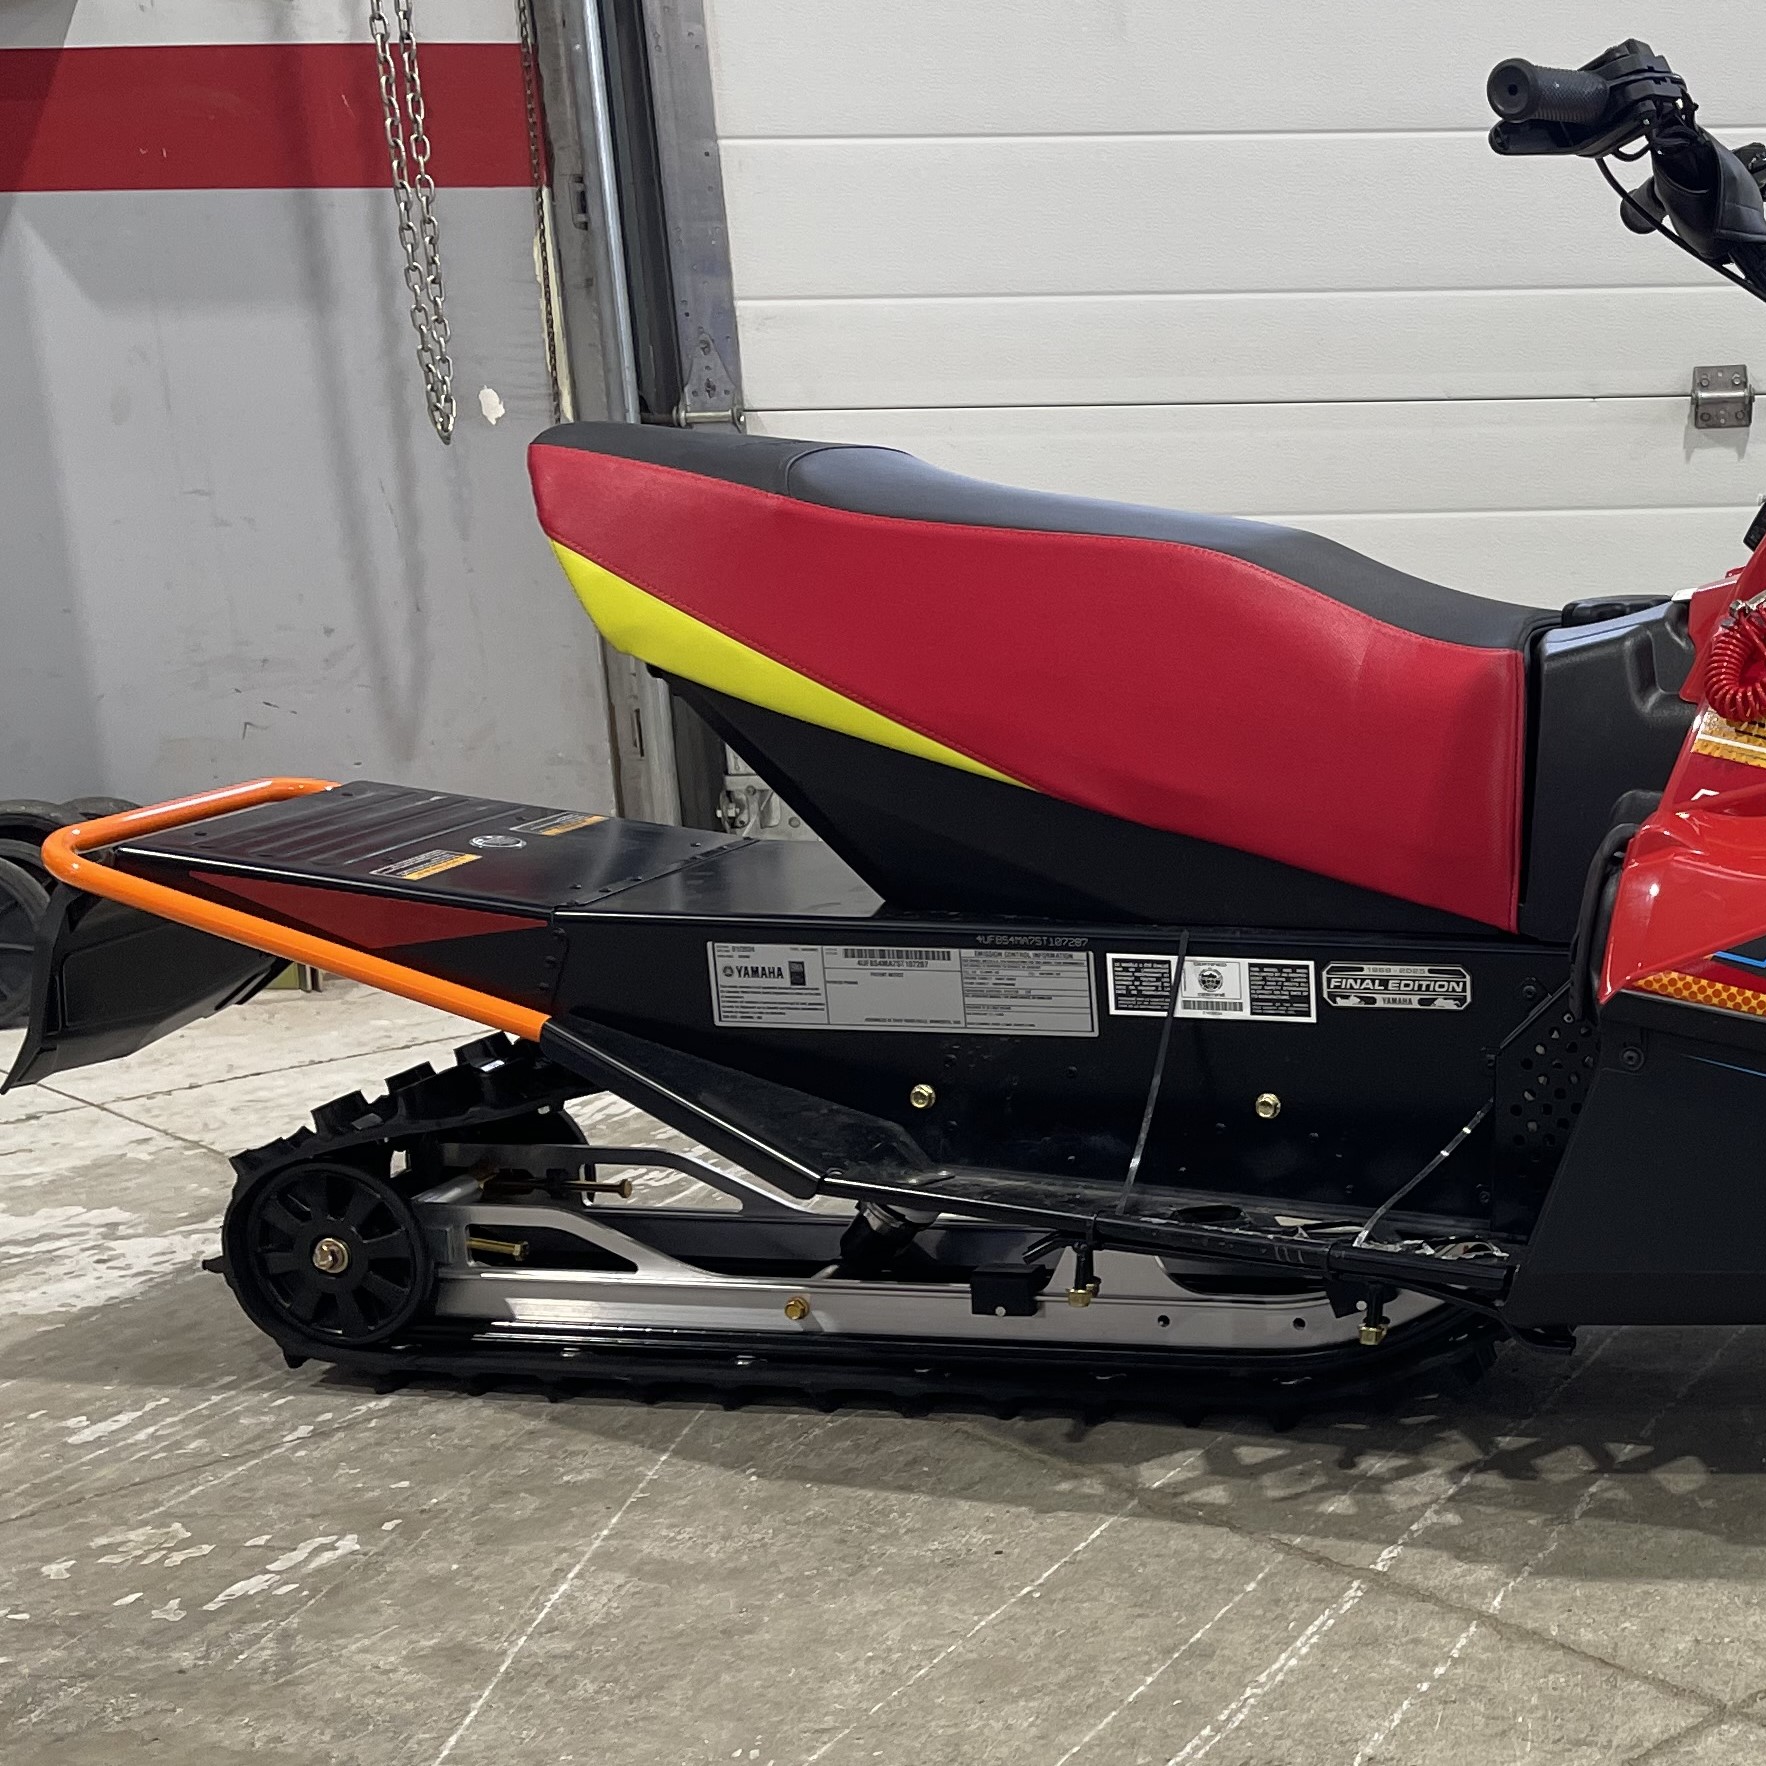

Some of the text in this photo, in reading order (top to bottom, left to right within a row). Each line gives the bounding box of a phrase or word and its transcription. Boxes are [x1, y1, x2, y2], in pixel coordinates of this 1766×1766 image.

[735, 965, 784, 979] YAMAHA
[1330, 978, 1464, 992] FINAL EDITION
[1382, 997, 1413, 1006] YAMAHA
